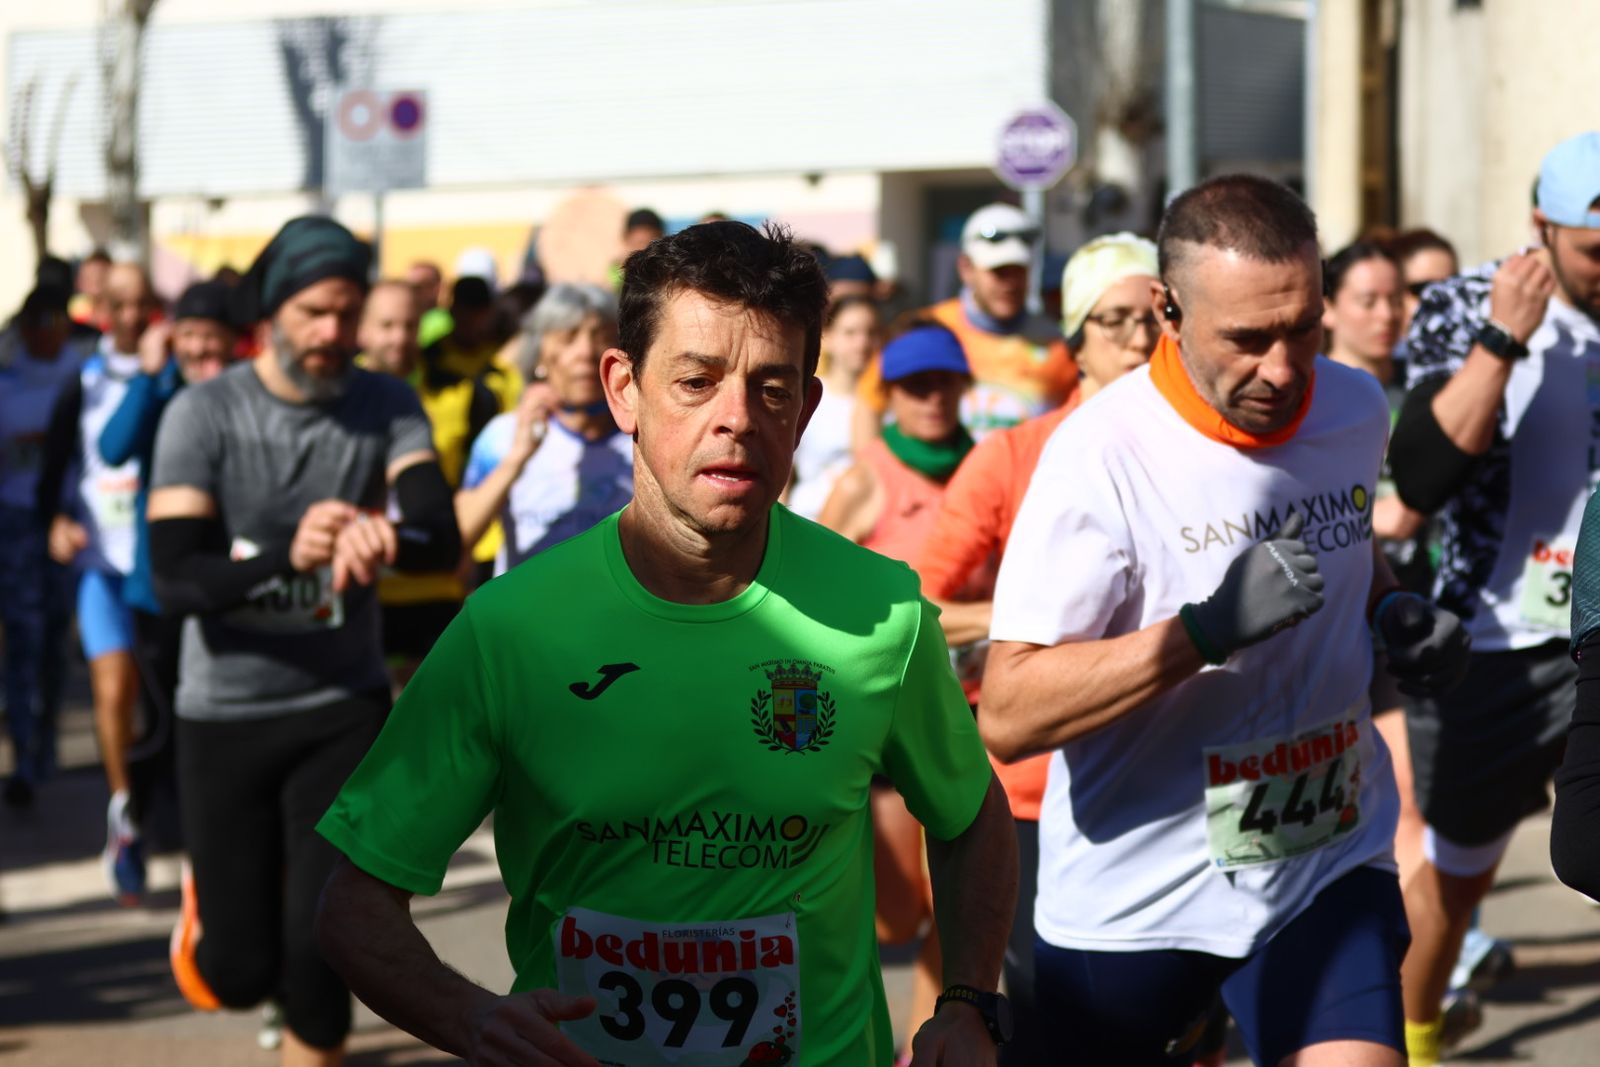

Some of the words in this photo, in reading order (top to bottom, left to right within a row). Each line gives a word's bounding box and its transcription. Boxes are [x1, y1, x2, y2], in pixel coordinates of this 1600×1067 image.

[1303, 517, 1361, 553] ECOM
[1238, 758, 1345, 835] 444
[576, 810, 809, 844] SANMAXIMO
[652, 839, 789, 870] TELECOM
[560, 915, 795, 974] bedunia
[598, 970, 760, 1049] 399
